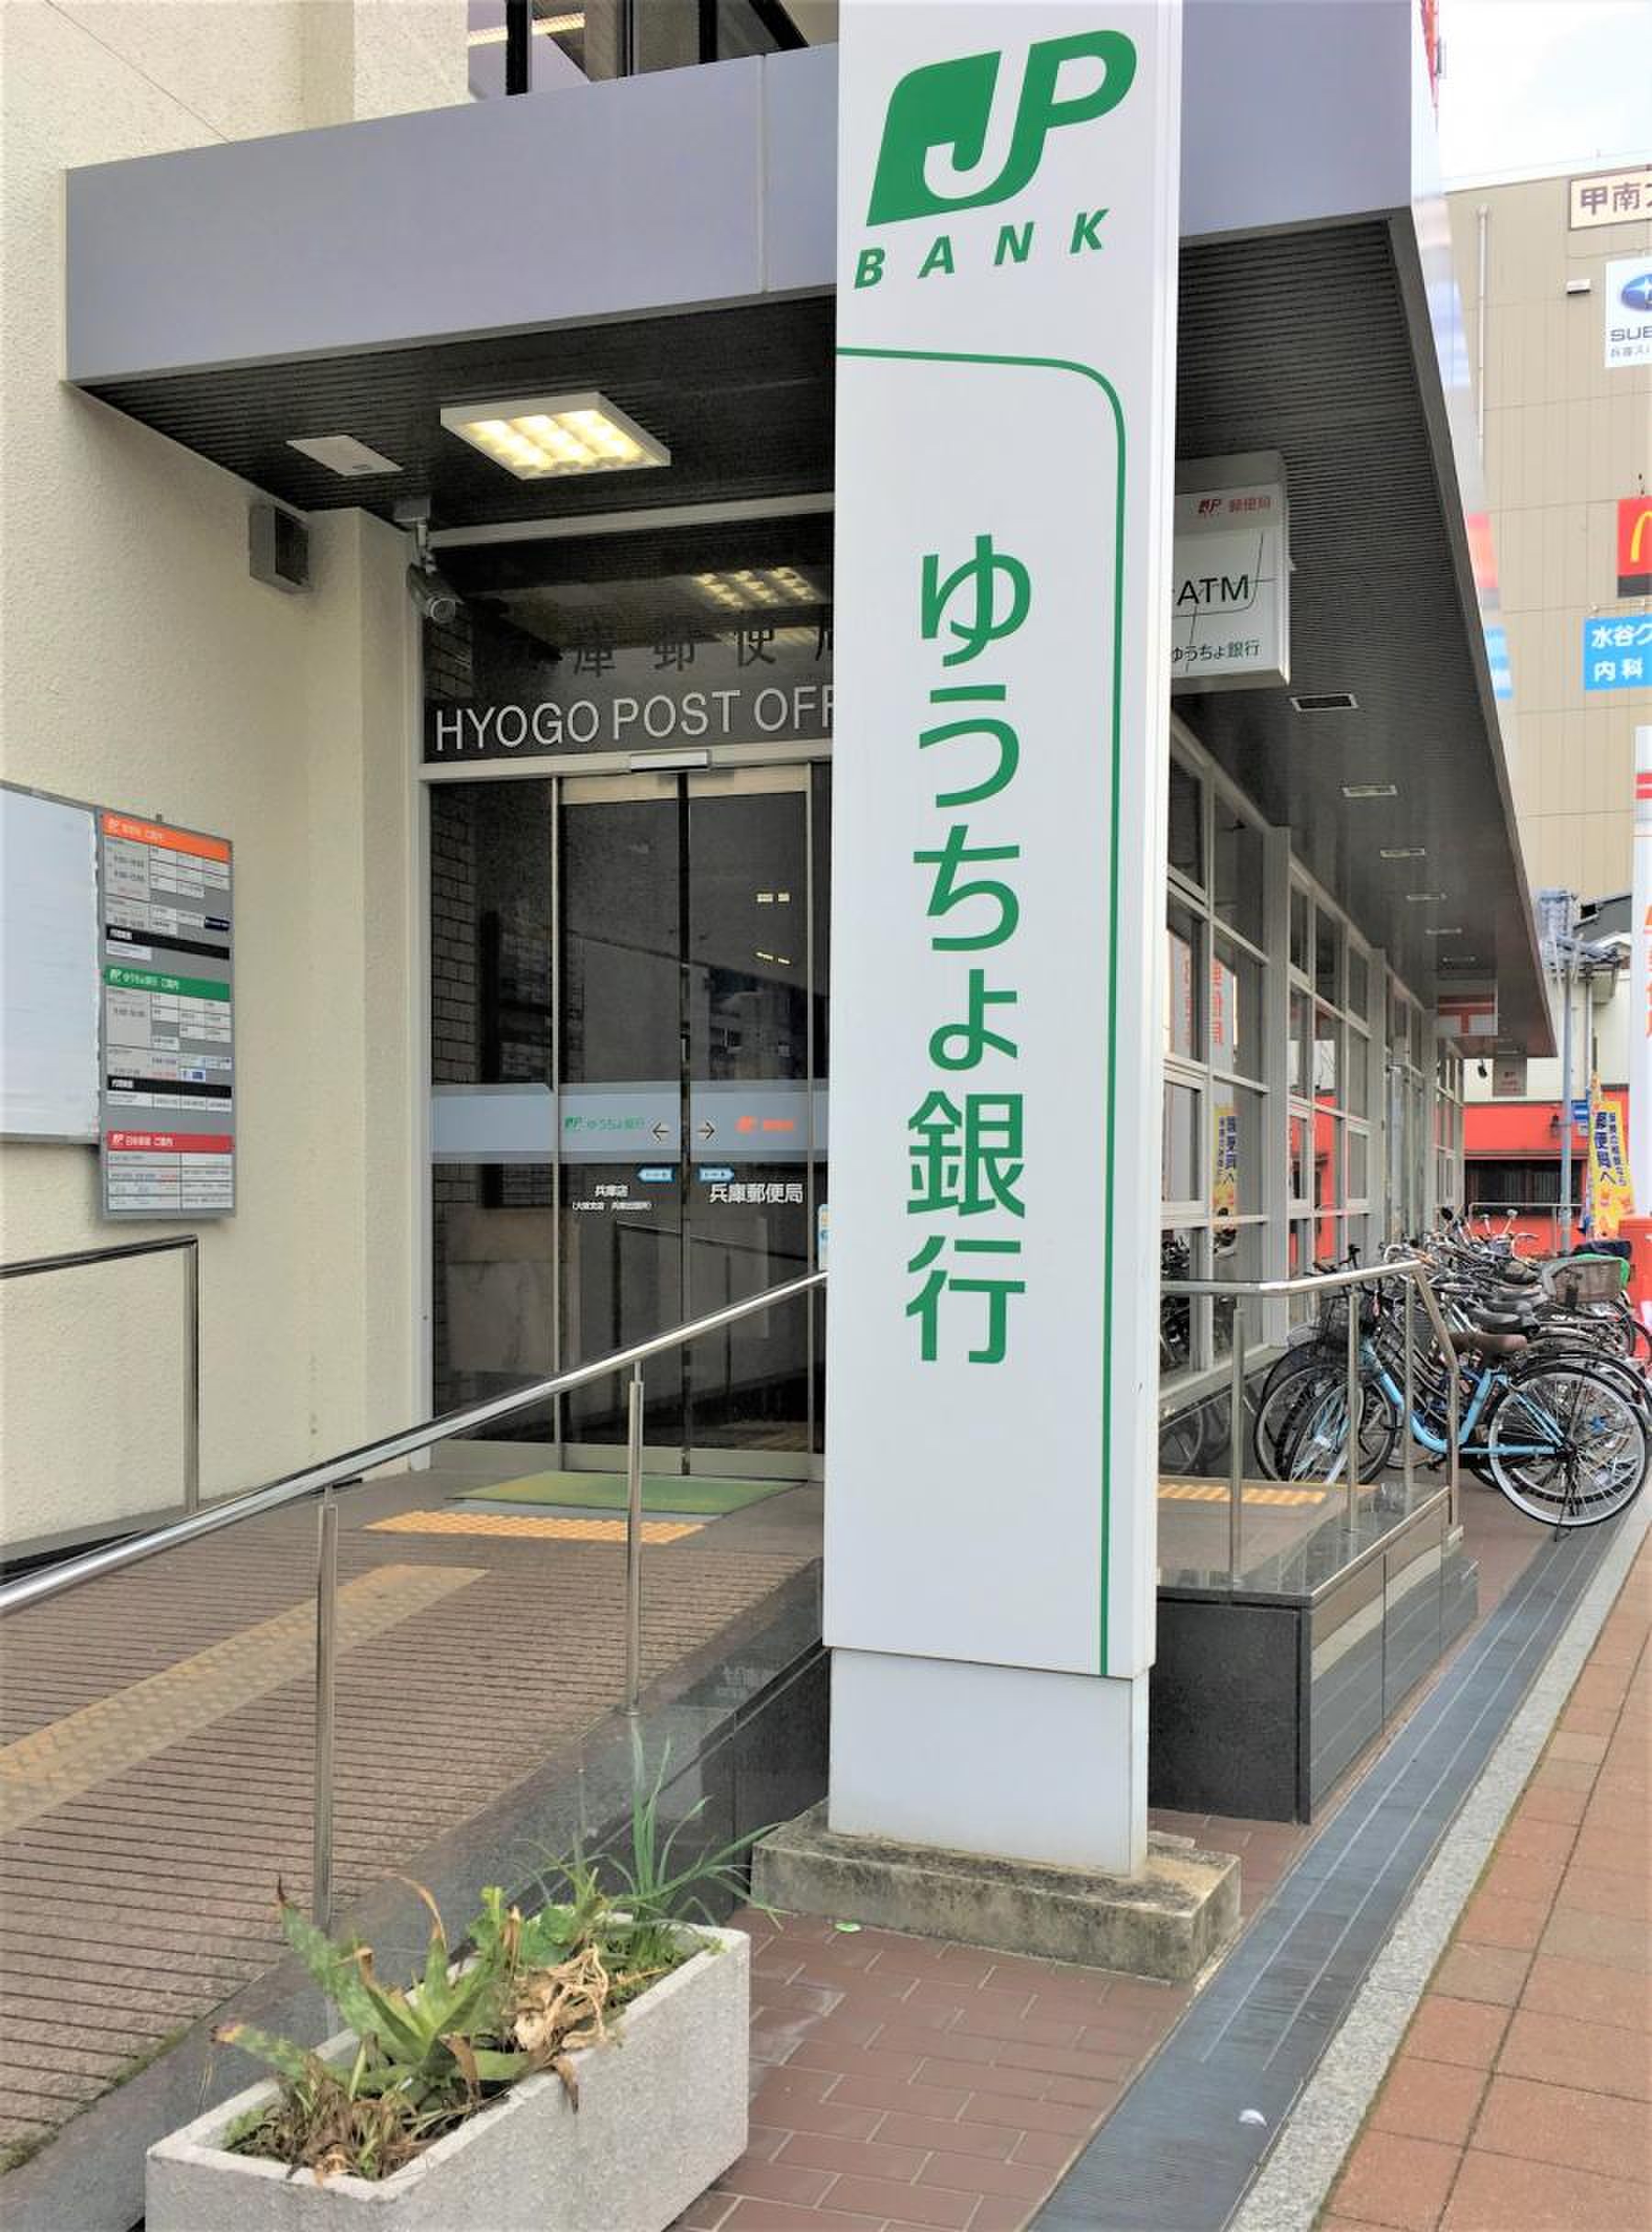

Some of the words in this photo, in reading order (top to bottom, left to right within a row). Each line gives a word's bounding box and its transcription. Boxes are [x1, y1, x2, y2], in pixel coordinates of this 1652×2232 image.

[854, 207, 1110, 290] BANK
[1177, 574, 1249, 606] ATM
[436, 700, 599, 751] HYOGO
[613, 689, 741, 741] POST
[906, 534, 1032, 1365] ゆうちょ銀行
[709, 1183, 804, 1204] 兵庫郵便局
